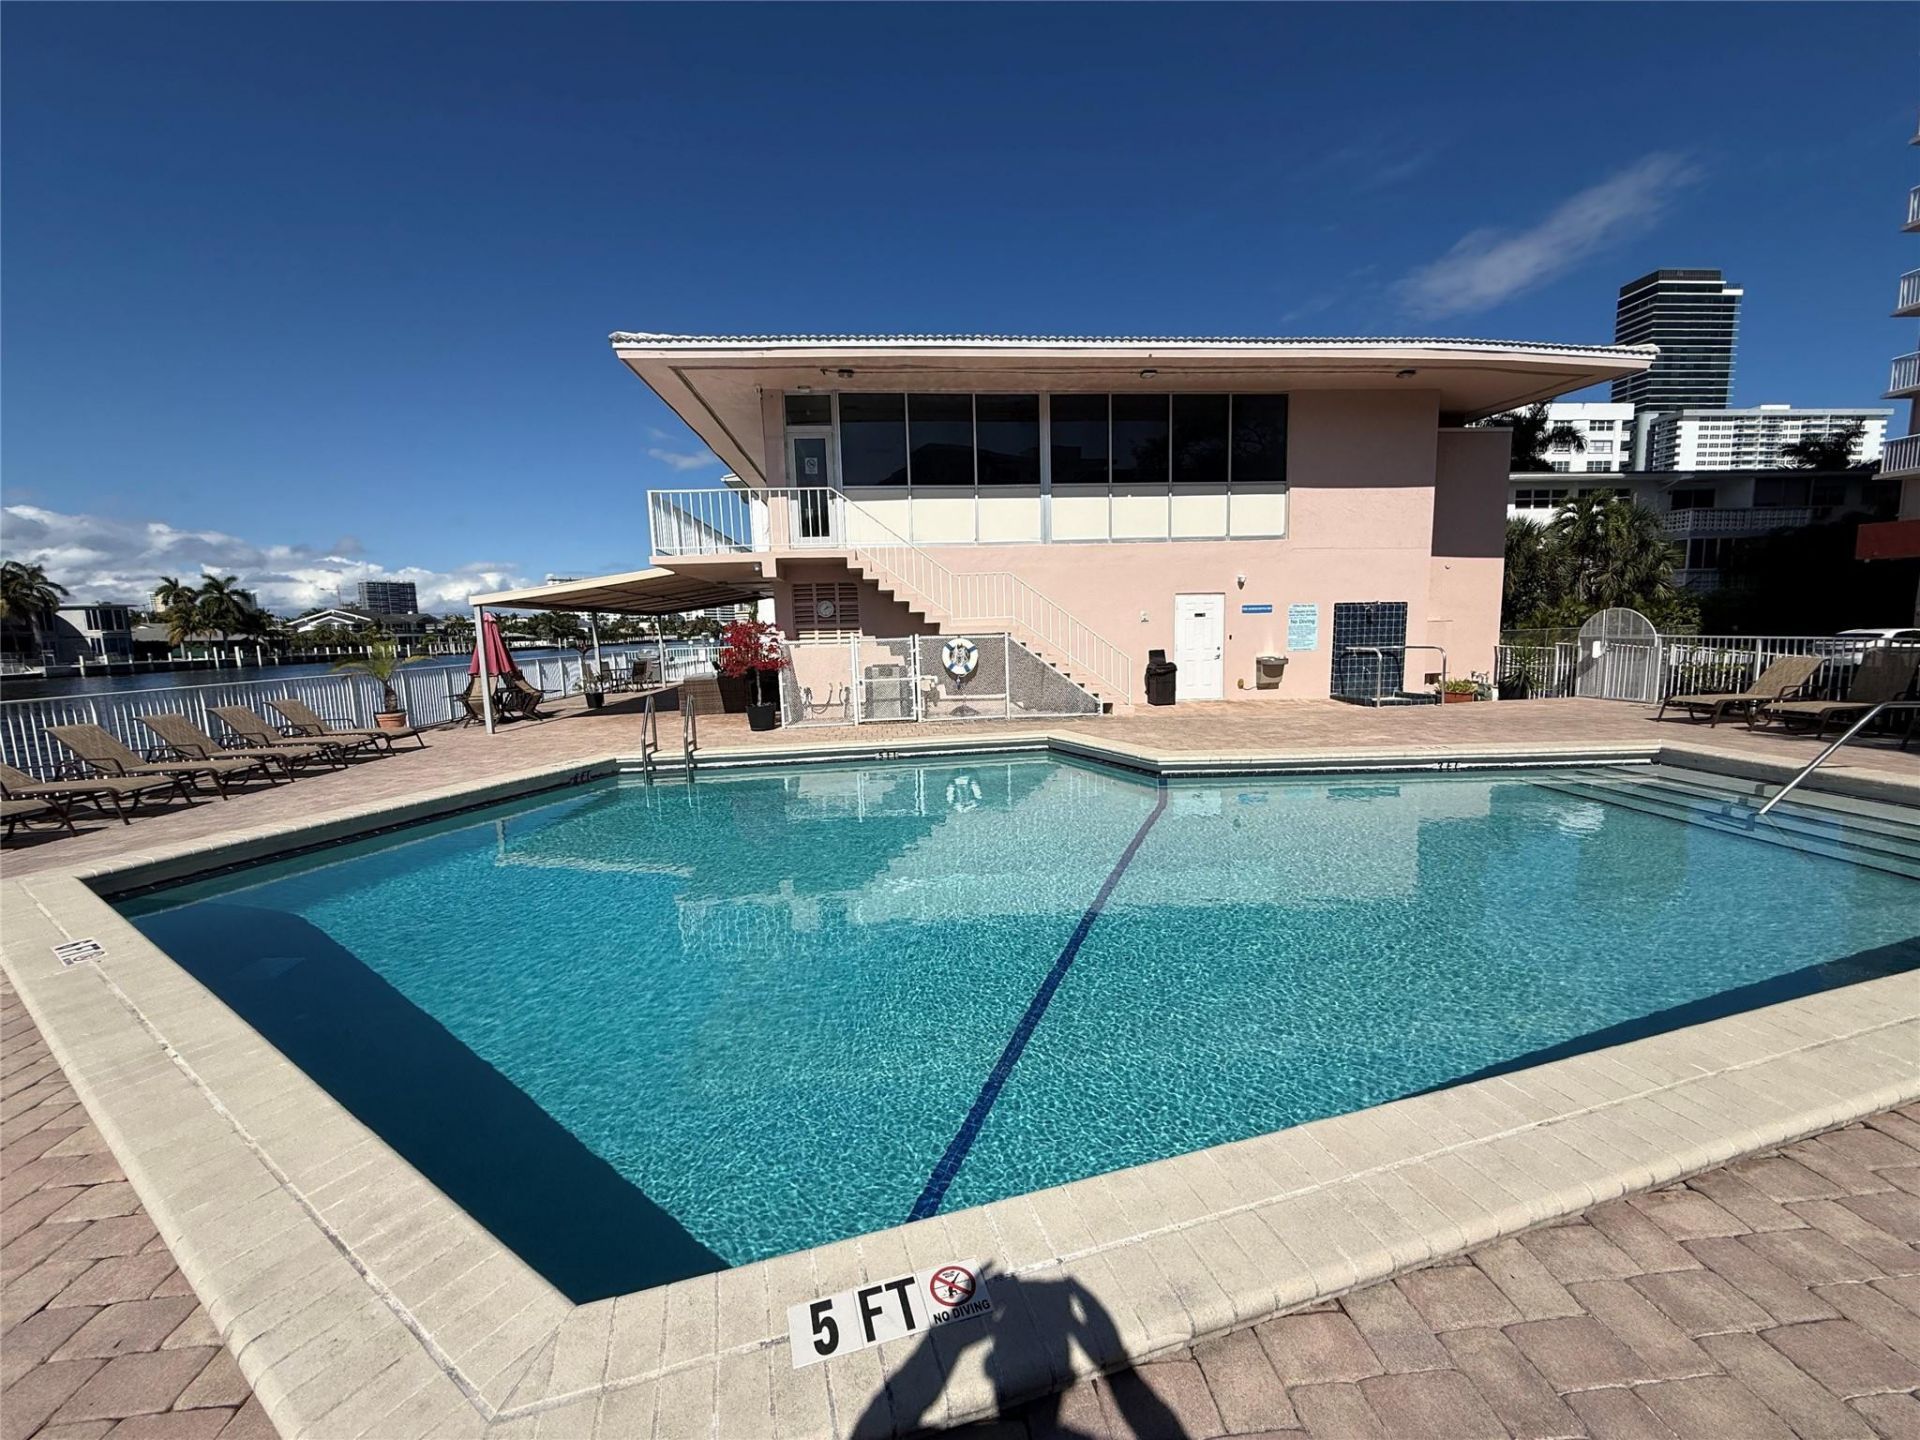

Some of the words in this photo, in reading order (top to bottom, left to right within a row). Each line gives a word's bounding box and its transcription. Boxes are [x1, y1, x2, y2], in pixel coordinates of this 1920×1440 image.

[809, 1299, 840, 1356] 5
[857, 1276, 916, 1343] FT
[933, 1310, 951, 1324] NO
[952, 1299, 991, 1320] DIVING
